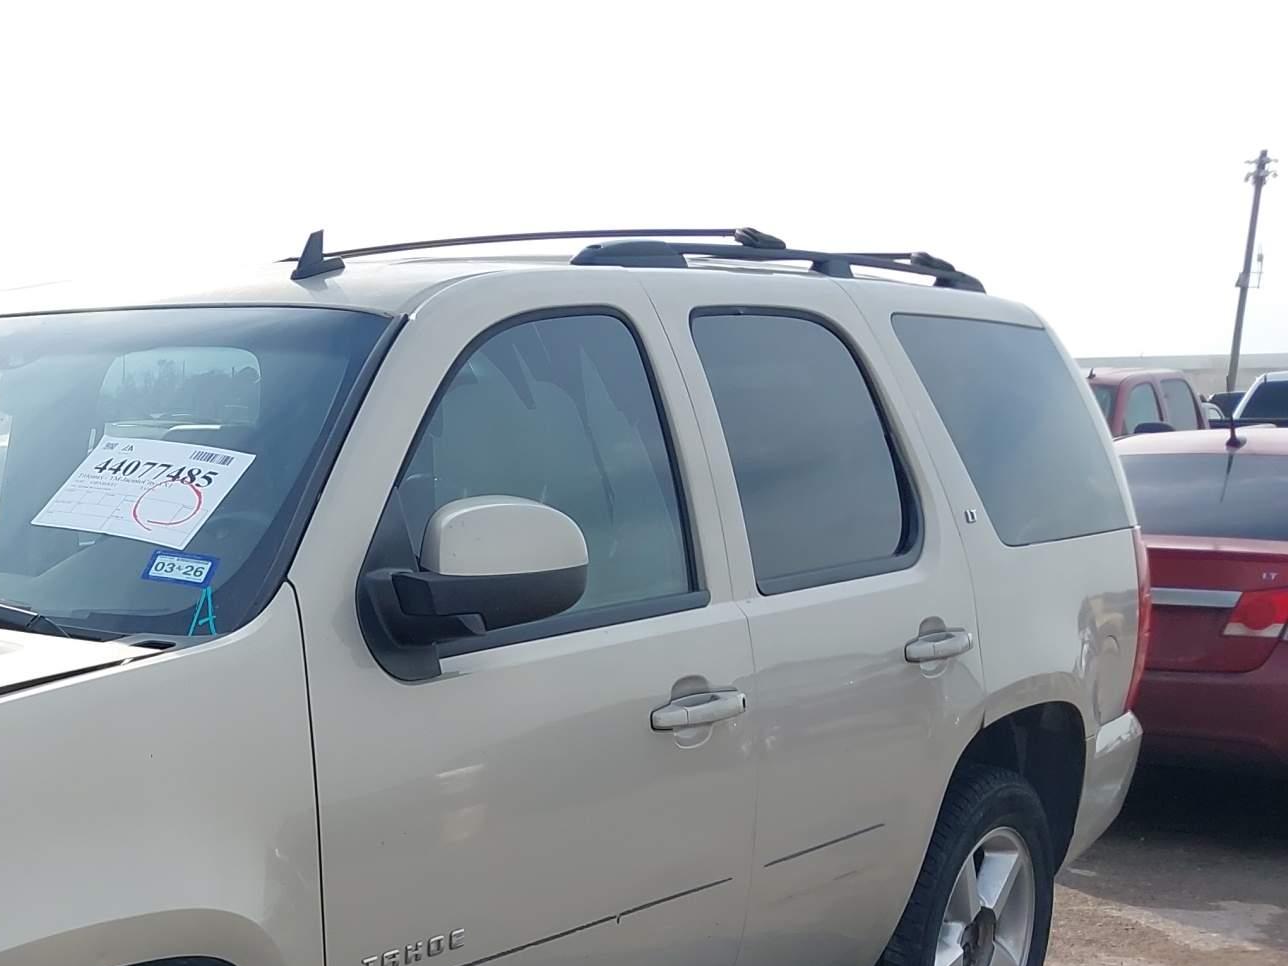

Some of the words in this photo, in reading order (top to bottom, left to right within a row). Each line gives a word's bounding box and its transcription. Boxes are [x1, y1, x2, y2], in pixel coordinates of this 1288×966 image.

[94, 458, 219, 488] 44077485
[964, 509, 977, 524] LT
[154, 561, 176, 574] 03
[182, 565, 205, 578] 26
